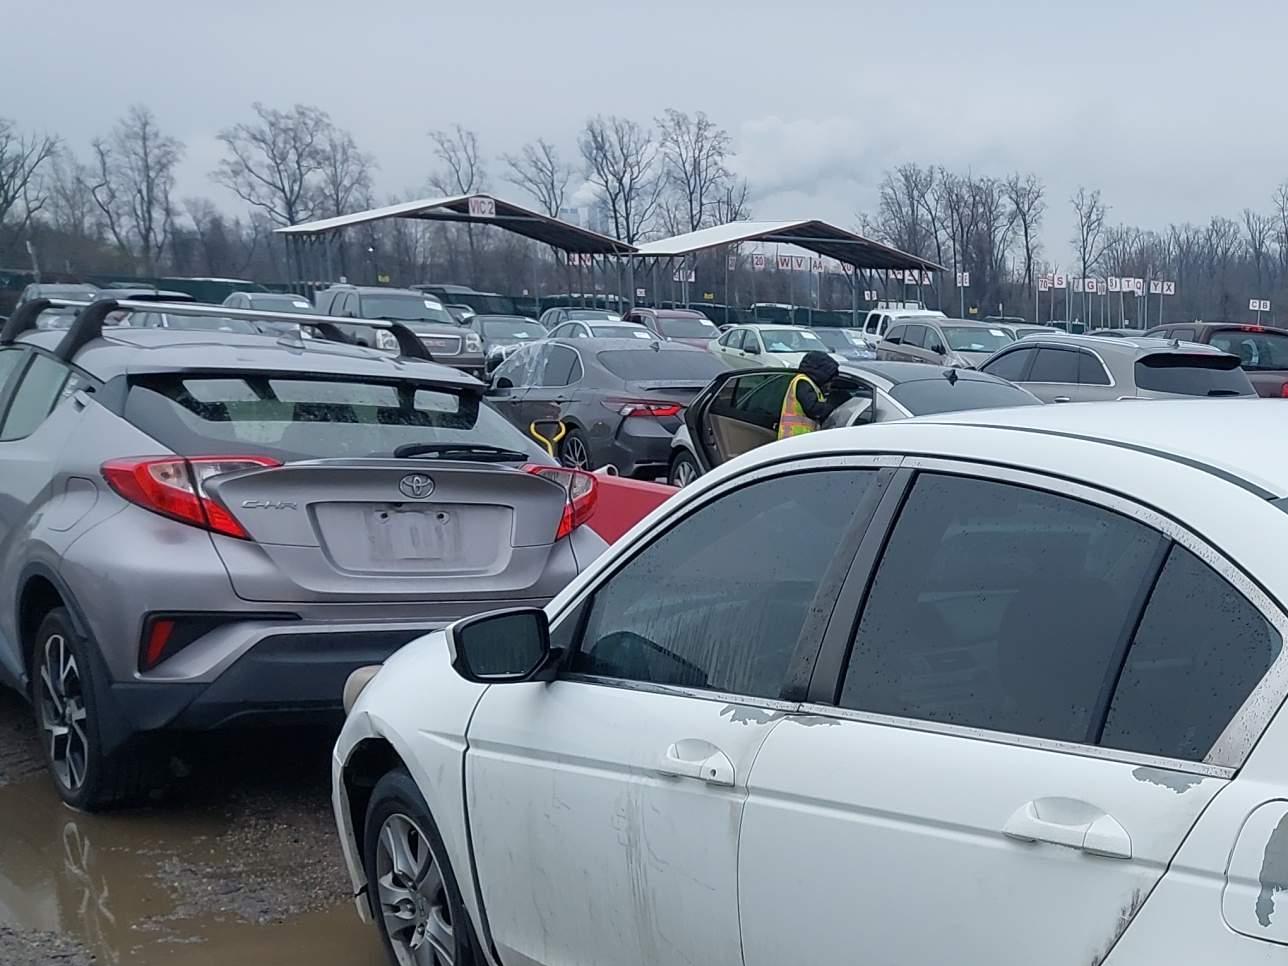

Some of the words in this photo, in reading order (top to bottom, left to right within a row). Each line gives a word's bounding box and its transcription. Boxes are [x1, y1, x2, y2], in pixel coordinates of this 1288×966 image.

[488, 202, 494, 214] 2
[781, 258, 790, 269] W
[797, 258, 803, 269] V
[1058, 277, 1064, 286] S
[1087, 280, 1095, 290] G
[1124, 280, 1131, 289] T
[1152, 282, 1160, 292] Y
[1165, 283, 1172, 293] X
[240, 500, 298, 510] C-HR
